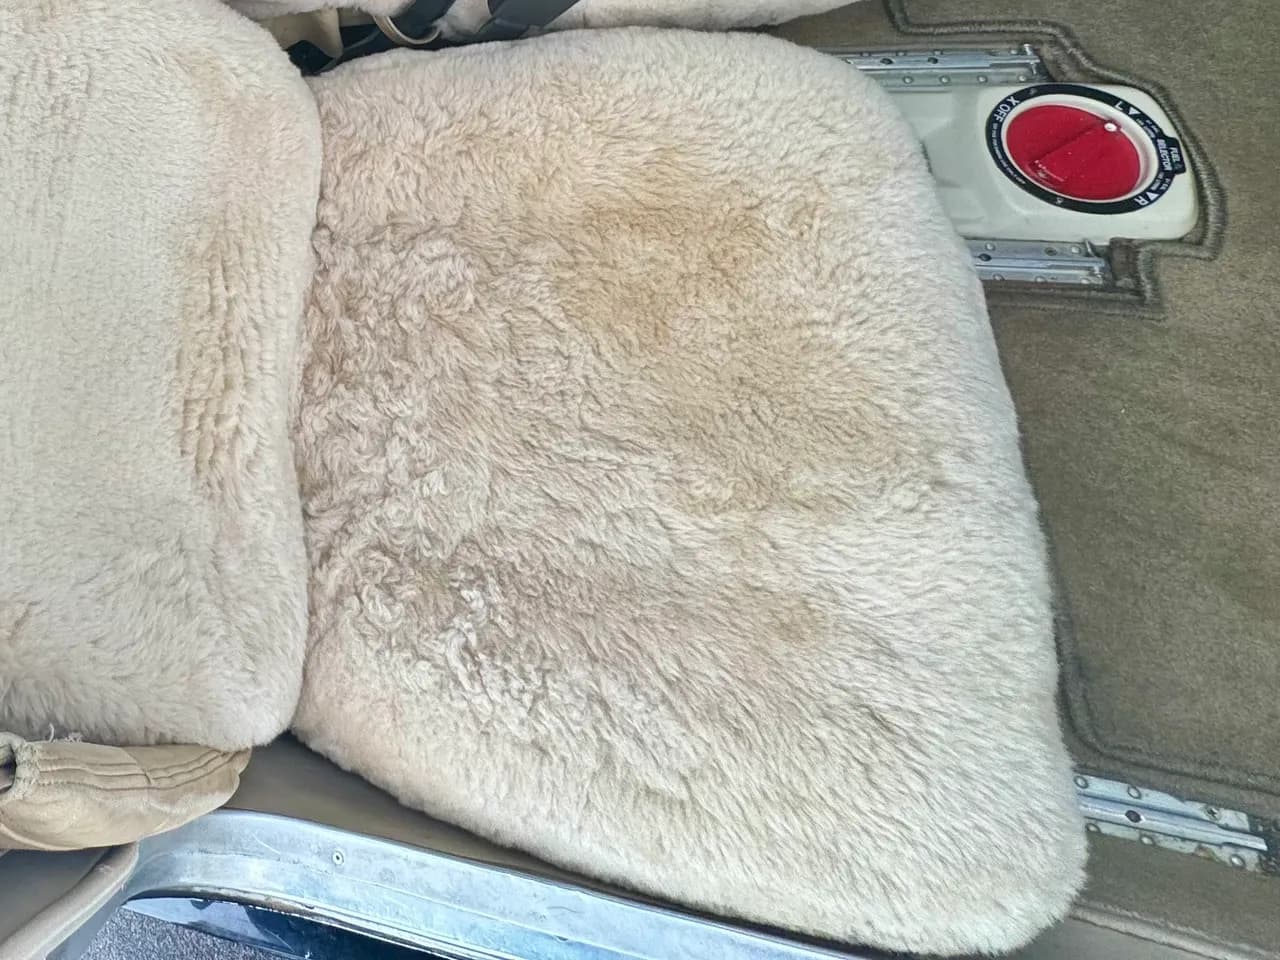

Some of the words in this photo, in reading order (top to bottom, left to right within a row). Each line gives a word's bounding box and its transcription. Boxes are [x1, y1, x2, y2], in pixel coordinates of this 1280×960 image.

[994, 104, 1012, 123] OFF
[1114, 100, 1124, 111] L
[1157, 139, 1173, 171] SELECTOR
[1170, 147, 1181, 163] FUEL
[1133, 196, 1147, 208] R
